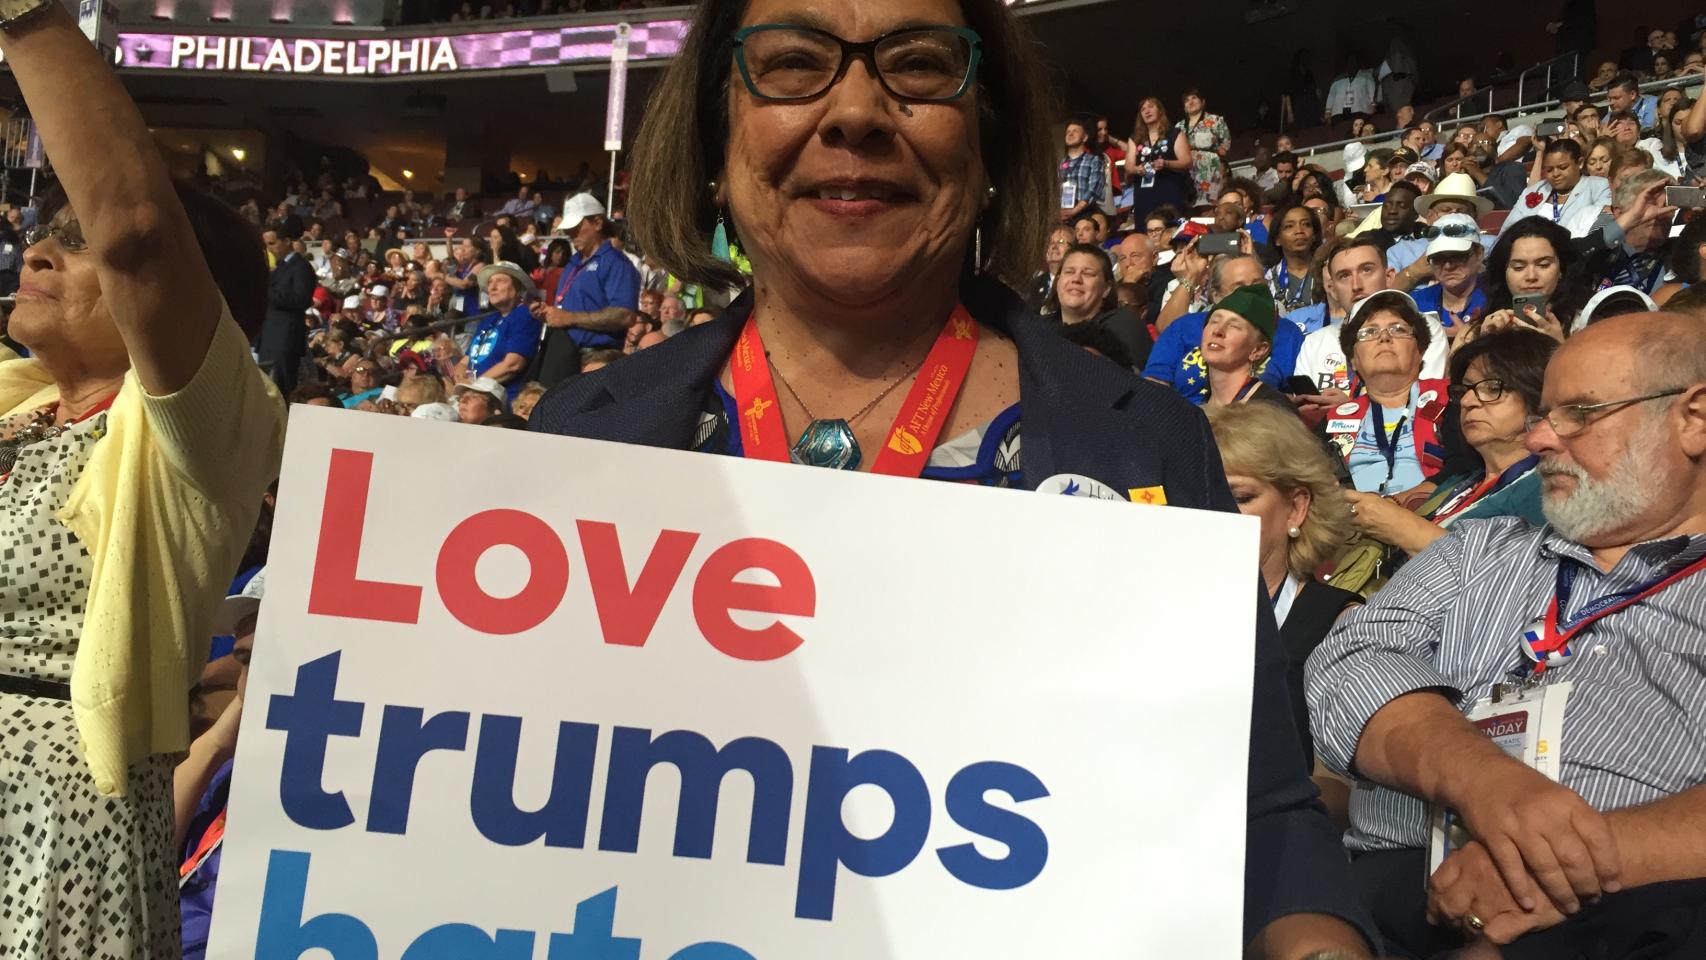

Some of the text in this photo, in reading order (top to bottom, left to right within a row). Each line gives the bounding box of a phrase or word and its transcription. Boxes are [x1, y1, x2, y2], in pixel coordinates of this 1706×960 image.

[171, 36, 458, 74] PHILADELPHIA
[917, 392, 934, 414] New
[927, 363, 949, 394] Mexico
[308, 449, 816, 661] Love
[266, 649, 1049, 920] trumps
